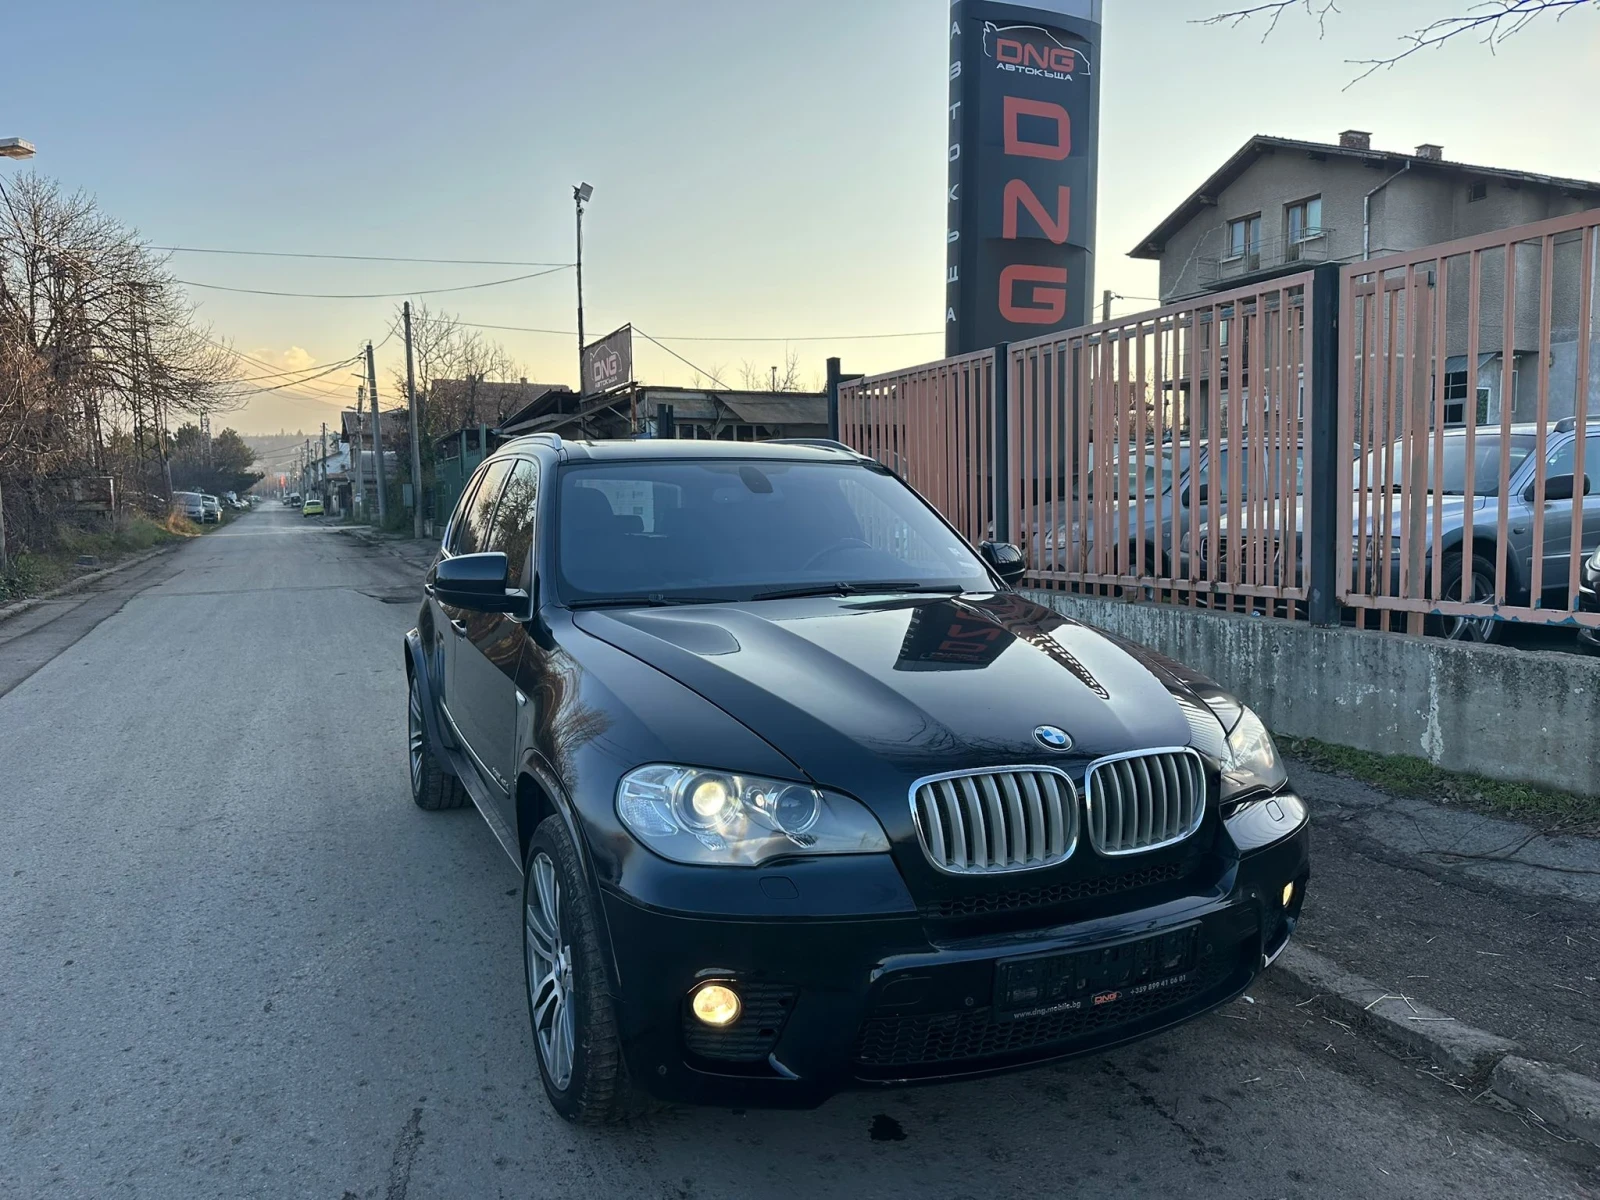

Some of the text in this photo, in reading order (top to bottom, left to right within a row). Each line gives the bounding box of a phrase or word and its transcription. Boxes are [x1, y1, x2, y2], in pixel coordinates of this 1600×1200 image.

[996, 38, 1075, 73] DNG
[996, 62, 1073, 81] АВТОКЪША
[998, 95, 1071, 325] DNG
[593, 354, 617, 382] DNG
